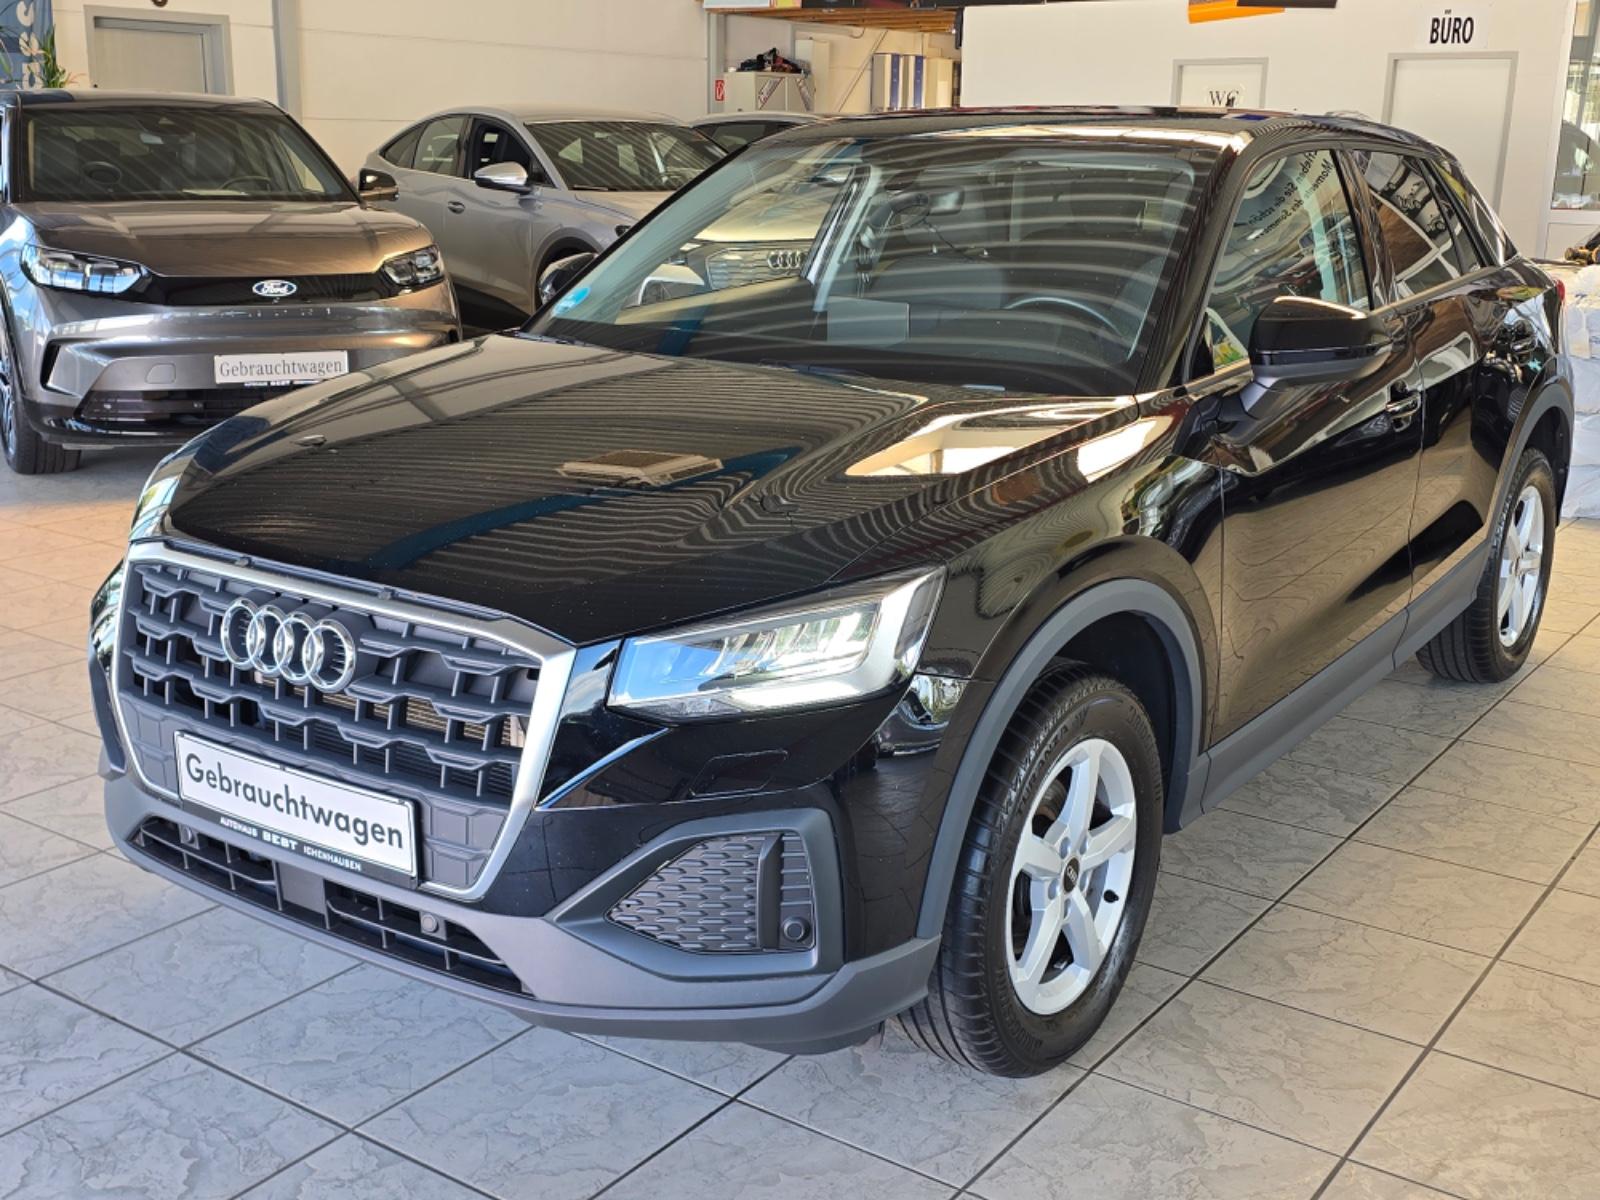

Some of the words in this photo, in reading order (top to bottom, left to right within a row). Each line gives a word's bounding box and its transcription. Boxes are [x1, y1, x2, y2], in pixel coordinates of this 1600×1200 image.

[1429, 9, 1474, 44] BÜRO
[220, 360, 342, 377] Gebrauchtwagen
[185, 753, 403, 849] Gebrauchtwagen
[220, 816, 258, 837] AUTOHAUS
[262, 830, 298, 851] BEST
[303, 846, 361, 871] ICHENHAUSEN
